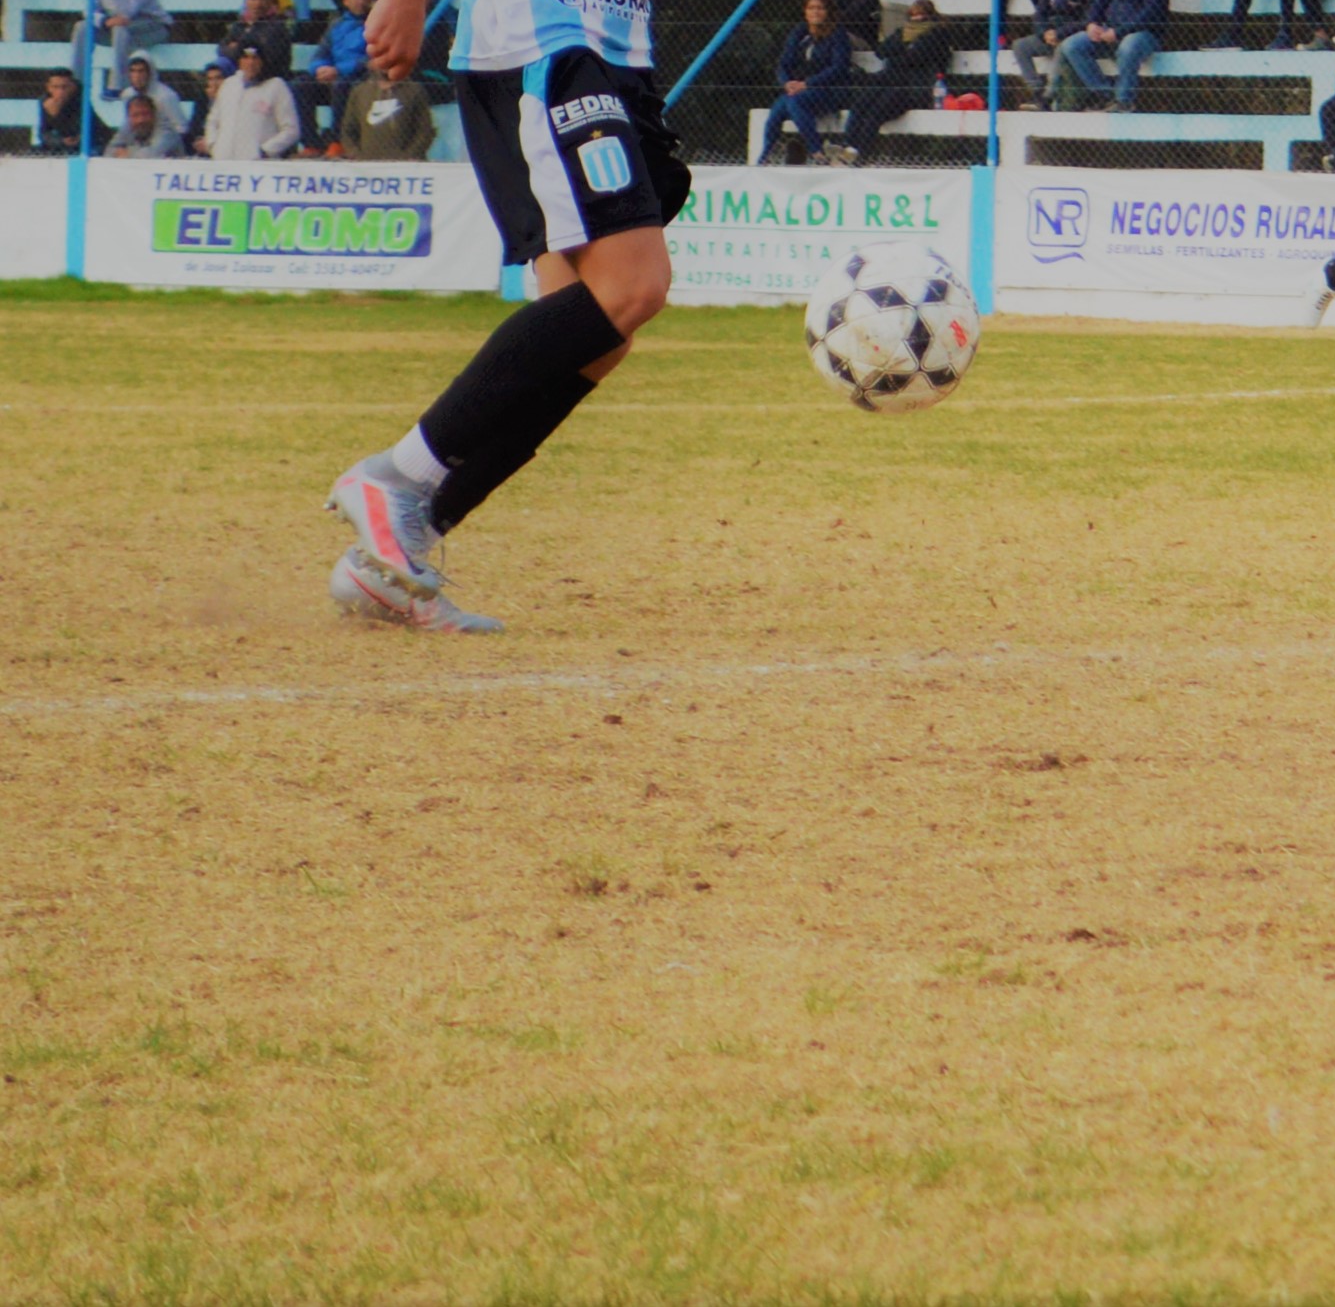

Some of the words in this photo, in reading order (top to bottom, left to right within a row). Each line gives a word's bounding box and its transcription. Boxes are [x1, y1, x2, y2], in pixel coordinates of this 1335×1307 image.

[154, 173, 241, 192] TALLER
[250, 175, 265, 193] Y
[272, 175, 435, 195] TRANSPORTE
[676, 189, 845, 227] RIMALDI
[864, 193, 940, 228] R&L
[1035, 198, 1084, 236] NR
[1110, 200, 1246, 238] NEGOCIOS
[174, 206, 235, 248] EL
[248, 205, 421, 254] MOMO
[667, 239, 832, 260] ONTRATISTA
[1105, 243, 1164, 257] SEMILLAS
[1175, 245, 1266, 260] FERTILIZANTES
